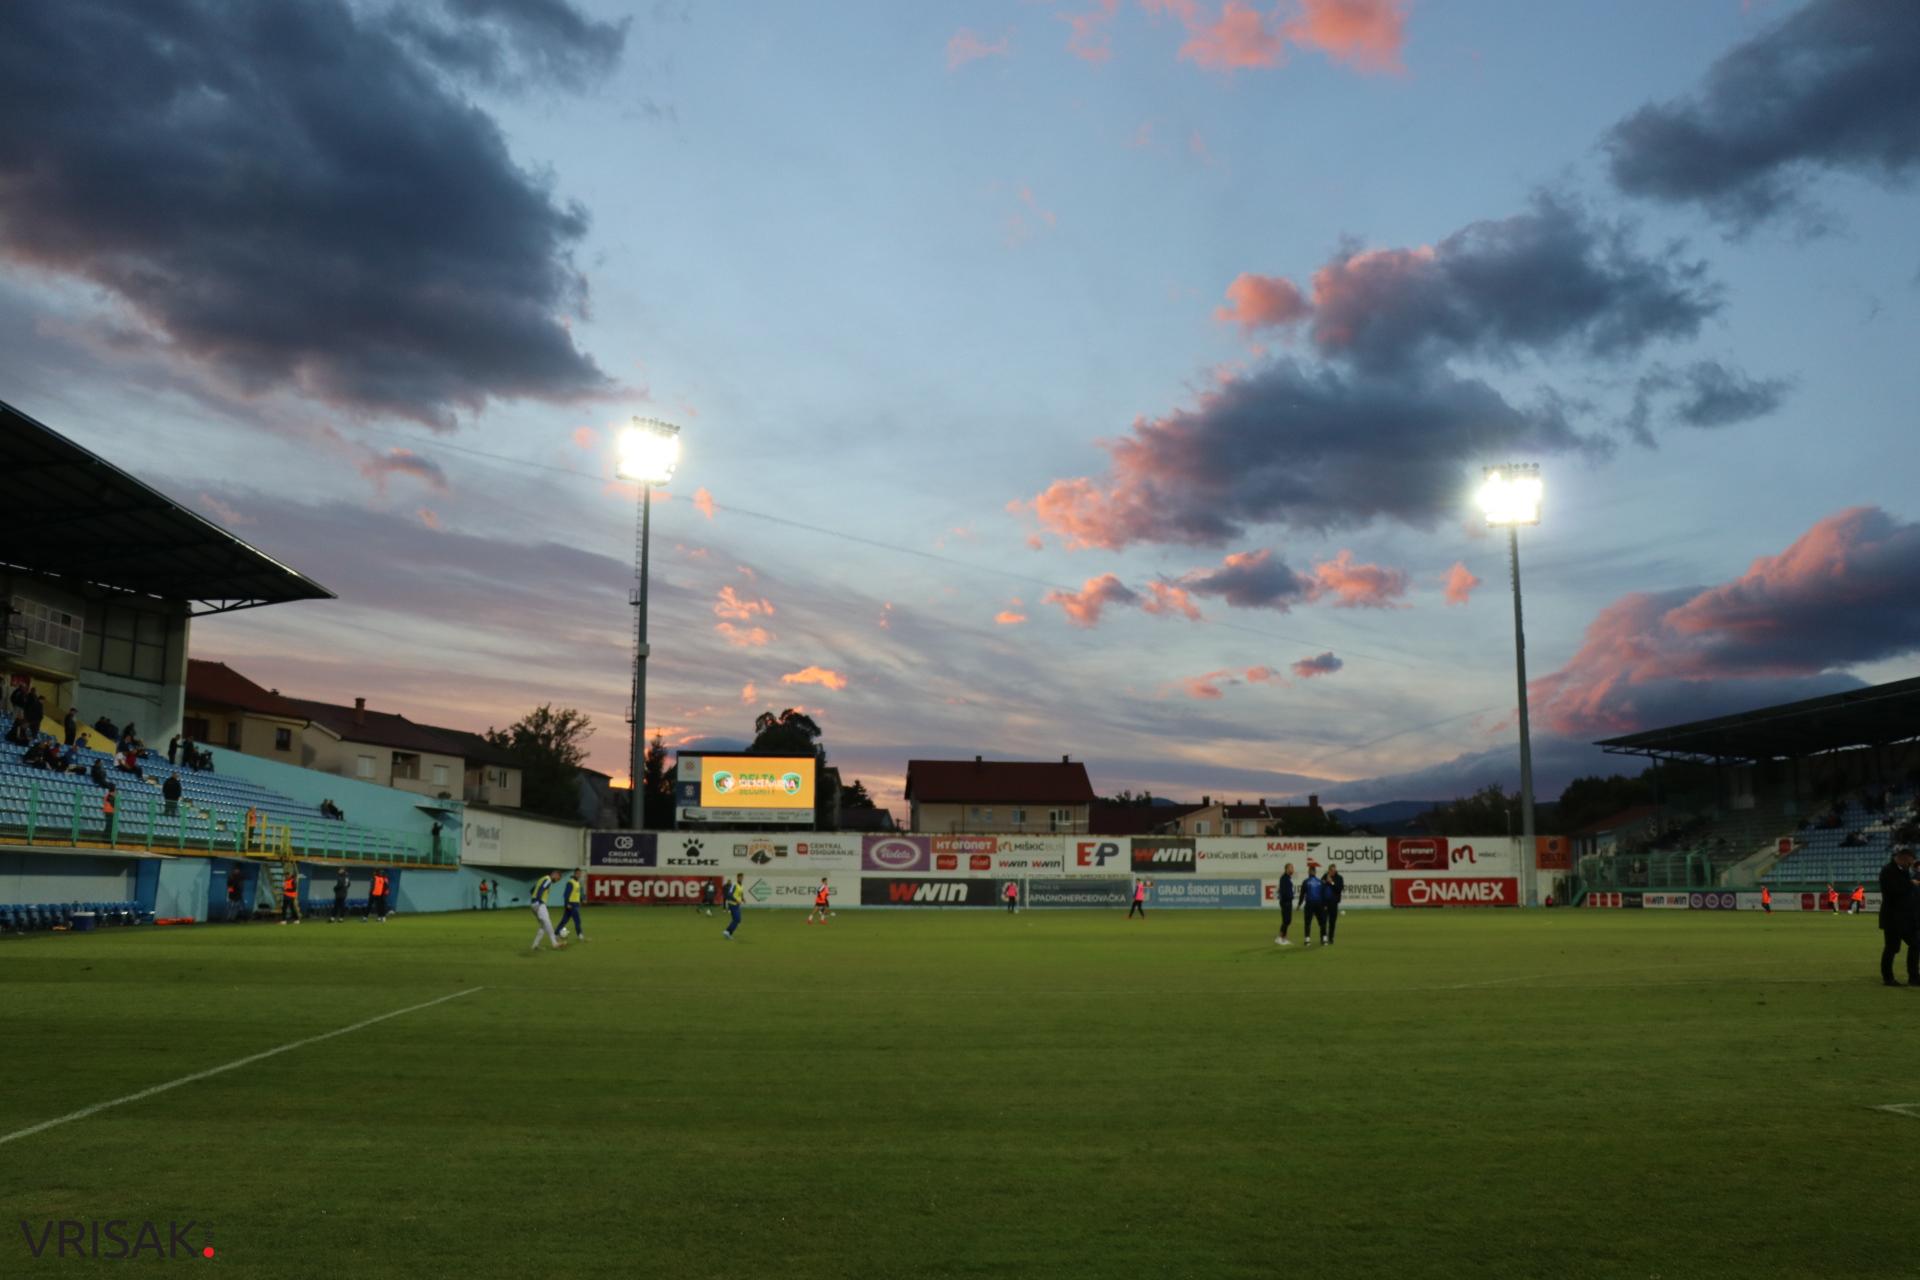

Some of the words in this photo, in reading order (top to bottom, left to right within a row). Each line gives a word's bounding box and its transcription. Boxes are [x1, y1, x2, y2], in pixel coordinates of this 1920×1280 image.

[1267, 842, 1305, 851] KAMIR
[1077, 842, 1119, 866] EP
[1206, 851, 1239, 859] UniCredit
[1240, 851, 1258, 859] Bank
[1327, 845, 1384, 864] Logotip
[667, 858, 719, 866] KELME
[595, 879, 625, 897] HT
[775, 886, 838, 895] EMERS
[1158, 885, 1185, 895] GRAD
[1187, 882, 1219, 895] ŠIROKI
[1222, 885, 1256, 896] BRIJEG
[1431, 882, 1504, 900] NAMEX
[1029, 893, 1127, 902] APADNOHERCEGOVAČKA
